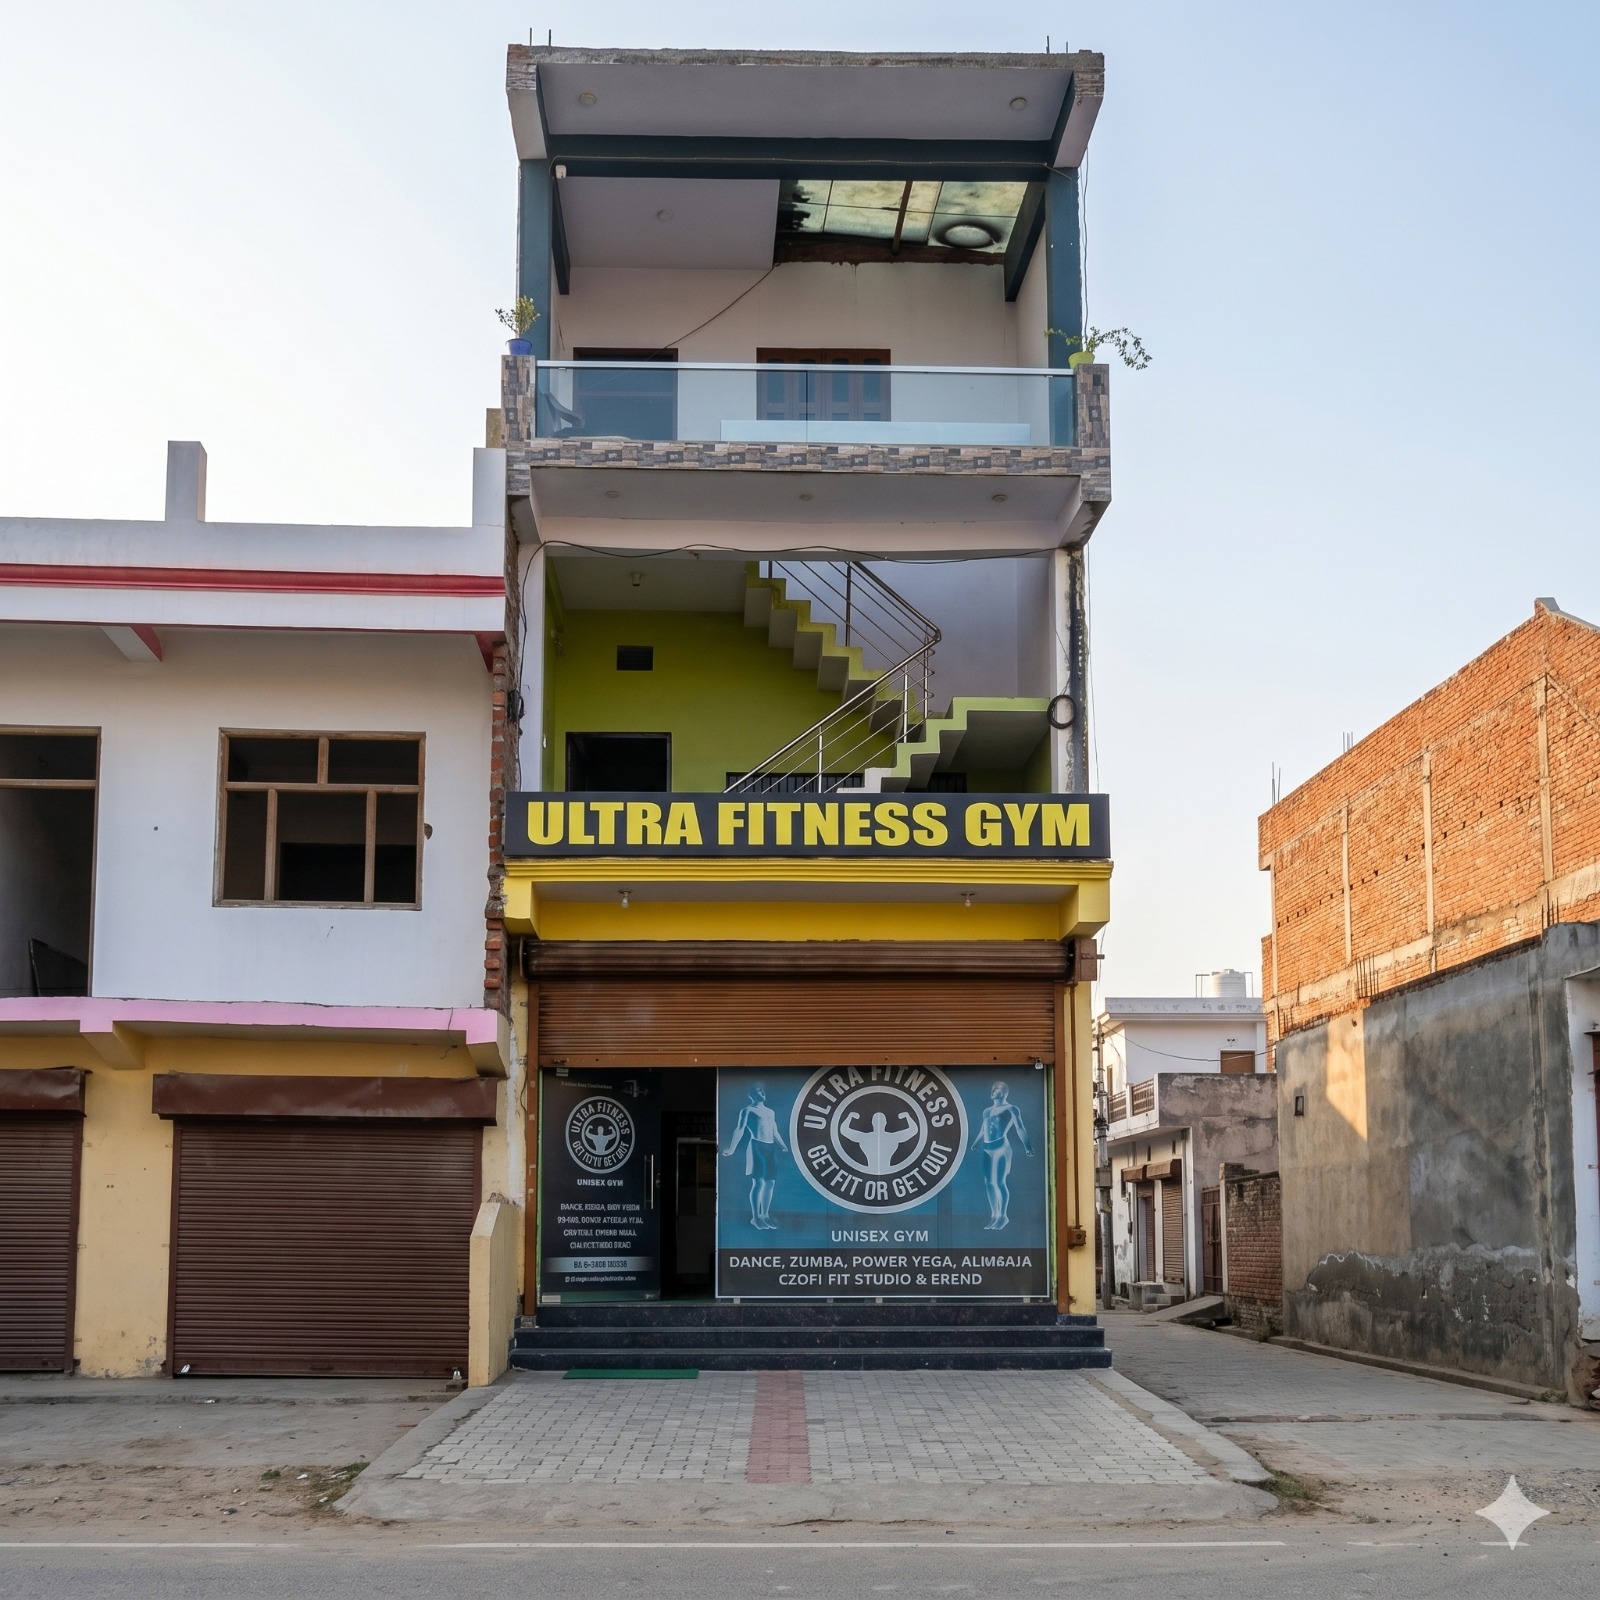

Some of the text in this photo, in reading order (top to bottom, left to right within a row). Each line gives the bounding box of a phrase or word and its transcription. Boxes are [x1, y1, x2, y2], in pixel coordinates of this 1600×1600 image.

[527, 801, 1090, 846] ULTRA FITNESS GYM
[803, 1065, 954, 1130] ULTRA FITNESS
[570, 1102, 631, 1135] ULTRA FITNESS
[577, 1179, 605, 1187] UNISEX
[807, 1144, 840, 1178] GET
[830, 1169, 863, 1196] FIT
[864, 1180, 889, 1201] OR
[892, 1167, 927, 1198] GET
[831, 1230, 929, 1242] UNISEX GYM
[729, 1256, 785, 1269] DANCE,
[789, 1256, 848, 1269] ZUMBA,
[852, 1256, 908, 1268] POWER
[912, 1256, 957, 1269] YEGA,
[779, 1273, 982, 1285] CZOFI FIT STUDIO & EREND
